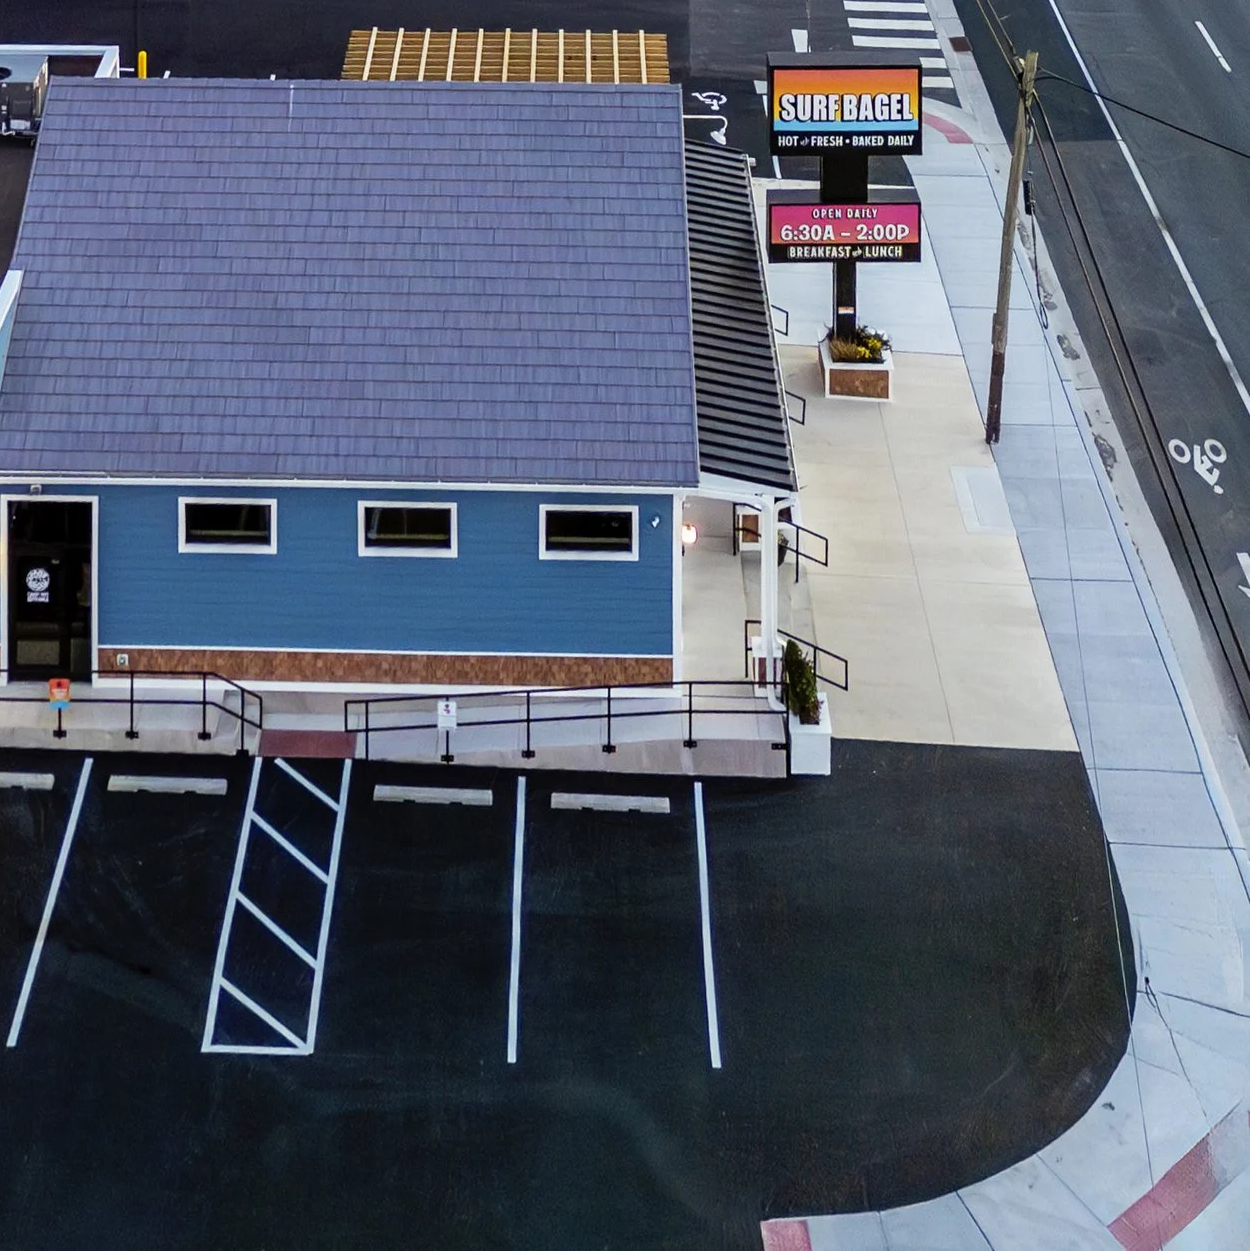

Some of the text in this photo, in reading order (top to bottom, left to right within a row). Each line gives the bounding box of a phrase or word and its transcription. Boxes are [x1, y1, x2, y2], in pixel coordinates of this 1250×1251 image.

[780, 93, 914, 122] SURF BAGEL
[778, 136, 799, 147] HOT
[811, 136, 843, 147] FRESH
[852, 135, 884, 147] BAKED
[888, 135, 914, 147] DAILY
[812, 209, 878, 219] OPEN DAILY
[781, 224, 835, 241] 6:30A
[856, 224, 910, 241] 2:00P
[789, 246, 851, 258] BREAKFAST
[865, 246, 903, 258] LUNCH
